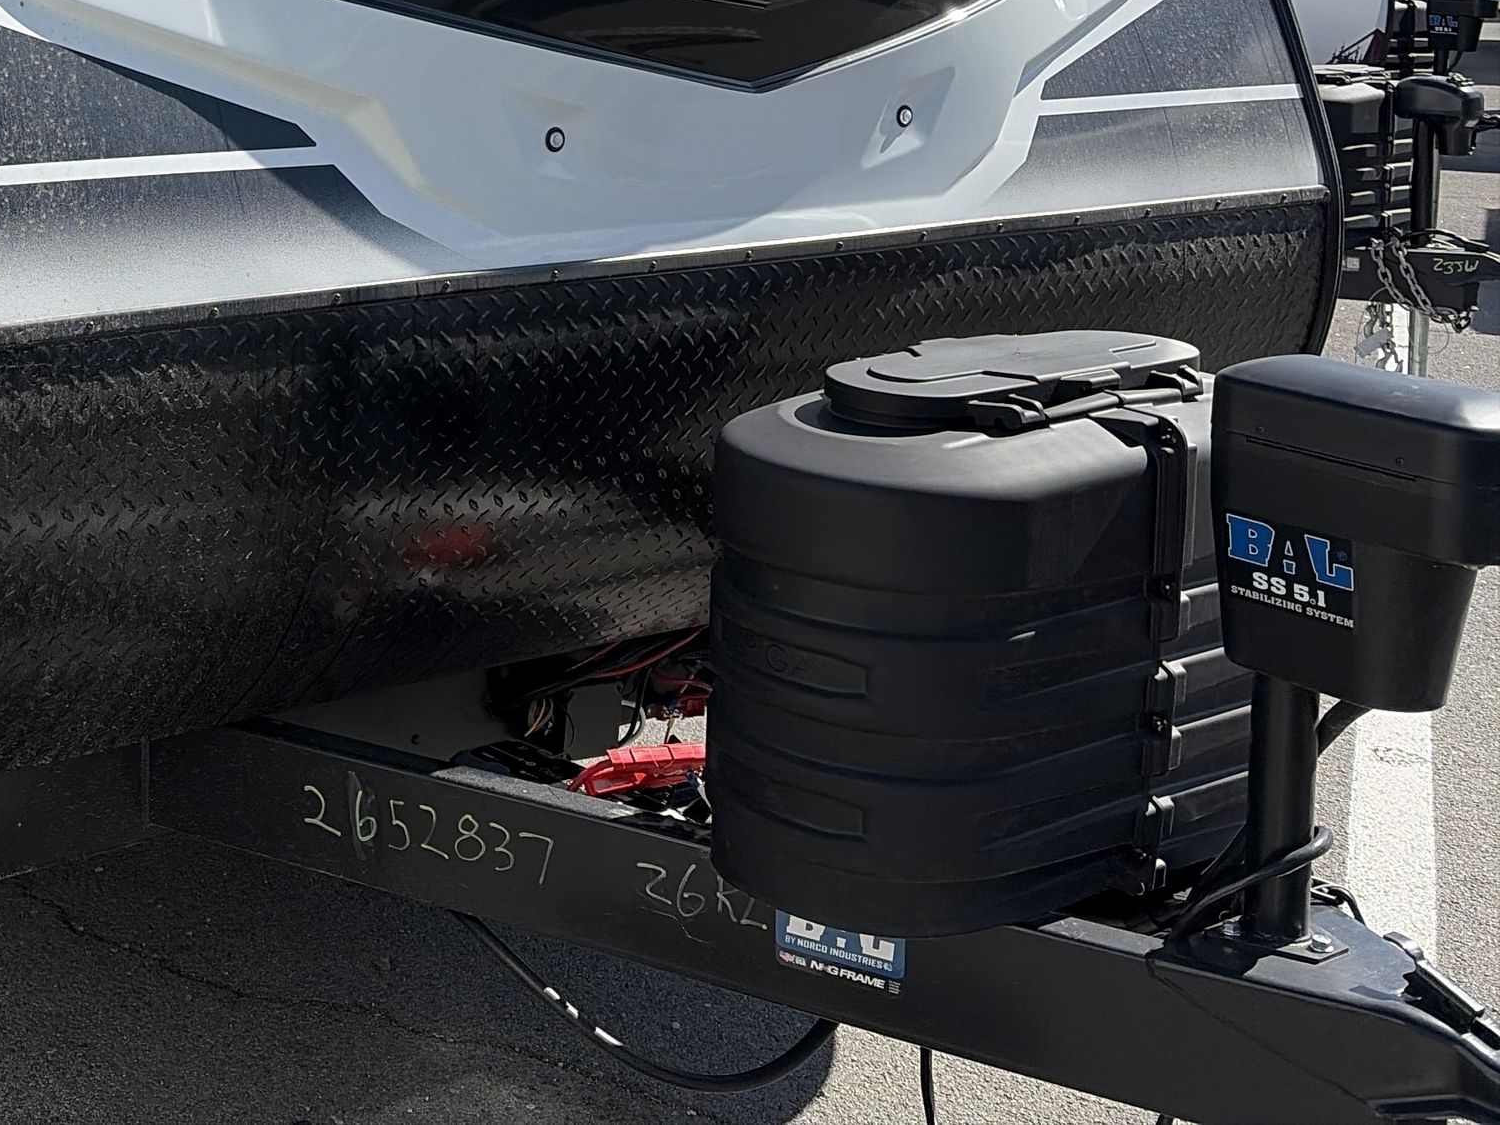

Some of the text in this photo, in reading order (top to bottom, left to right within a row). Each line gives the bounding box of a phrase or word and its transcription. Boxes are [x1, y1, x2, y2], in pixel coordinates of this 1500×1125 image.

[1226, 513, 1354, 591] BAL
[1230, 584, 1355, 629] STABILIZING SYSTEM
[1252, 572, 1327, 608] SS 5.1
[303, 784, 554, 885] 2652837
[784, 934, 884, 970] BY NORCO INDUSTRIES
[839, 968, 887, 990] FRAME
